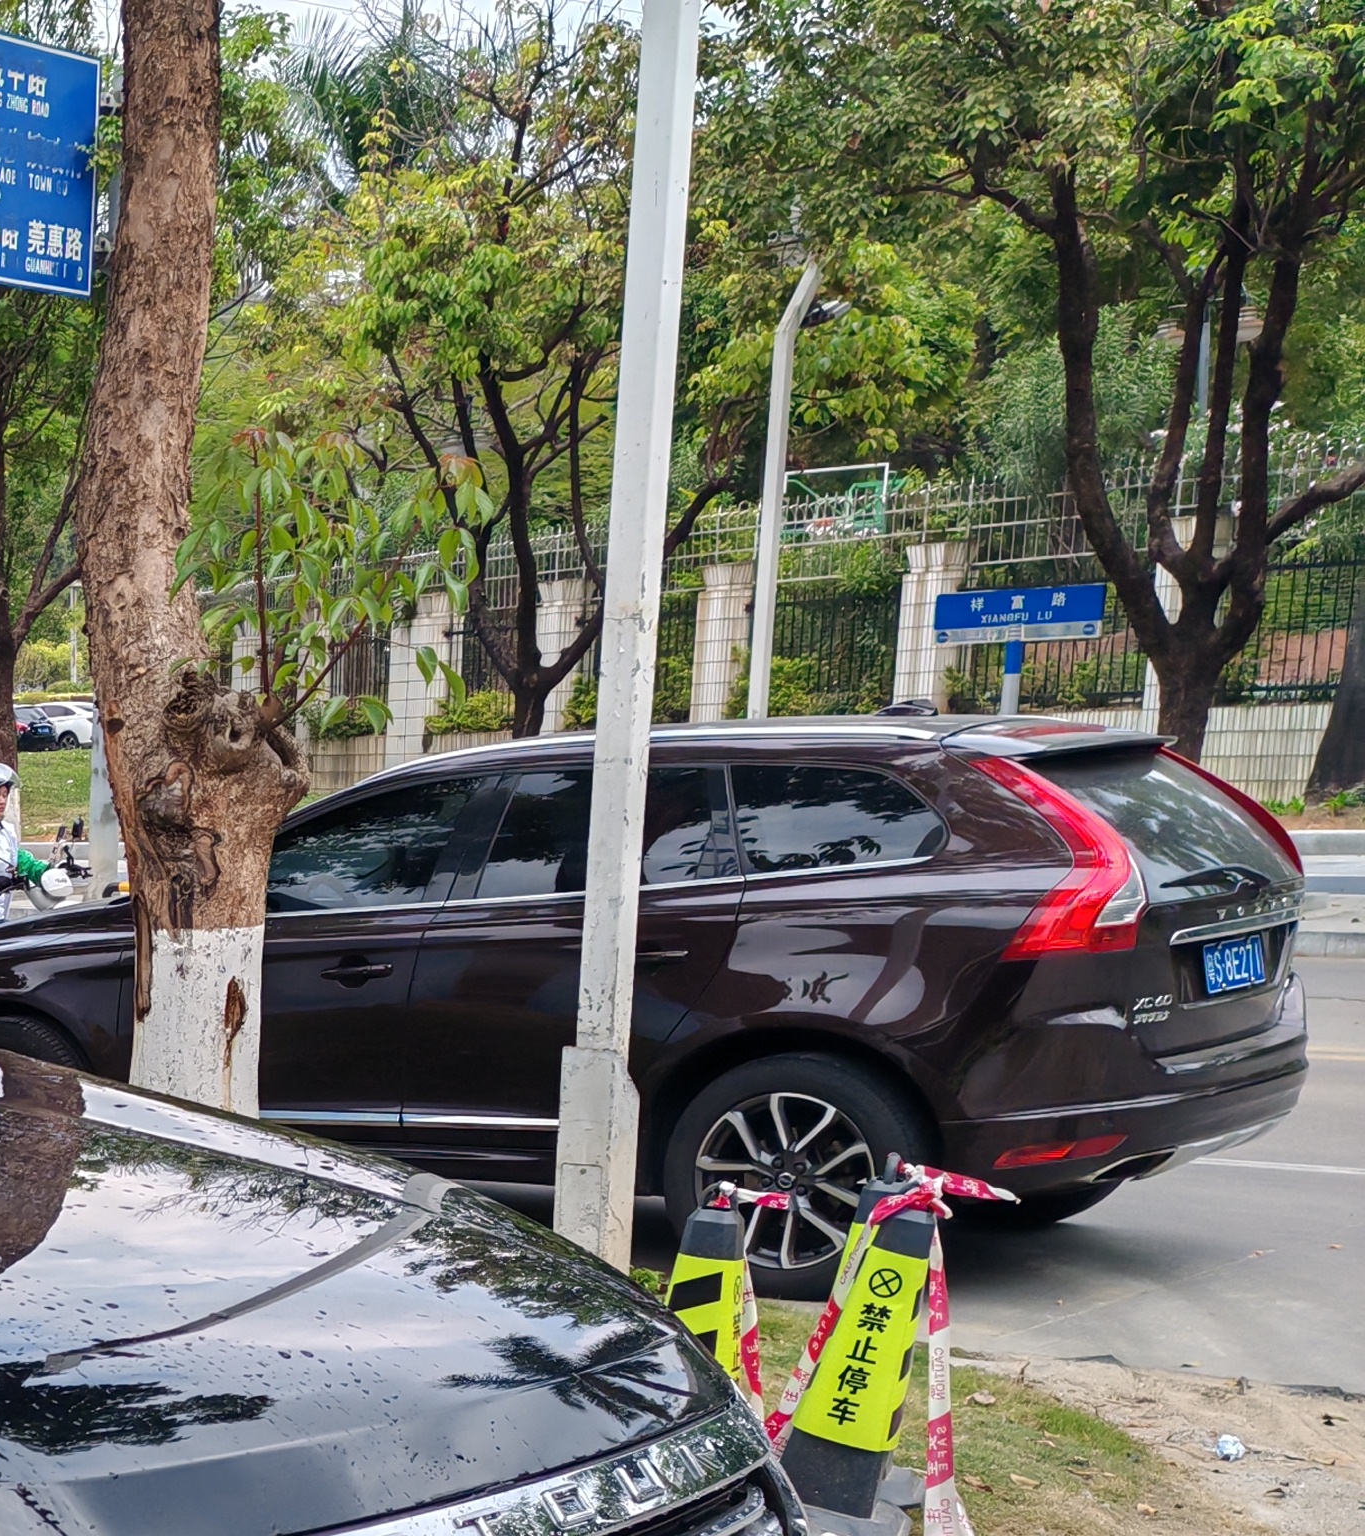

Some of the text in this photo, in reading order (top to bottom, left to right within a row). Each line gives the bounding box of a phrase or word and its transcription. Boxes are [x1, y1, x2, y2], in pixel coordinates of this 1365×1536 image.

[29, 173, 53, 194] TOWN
[27, 218, 84, 262] 莞惠路
[970, 591, 1067, 613] 祥富路
[980, 610, 1053, 624] XIANGFU LU
[1133, 993, 1173, 1011] XC60
[827, 1302, 893, 1426] 禁止停车
